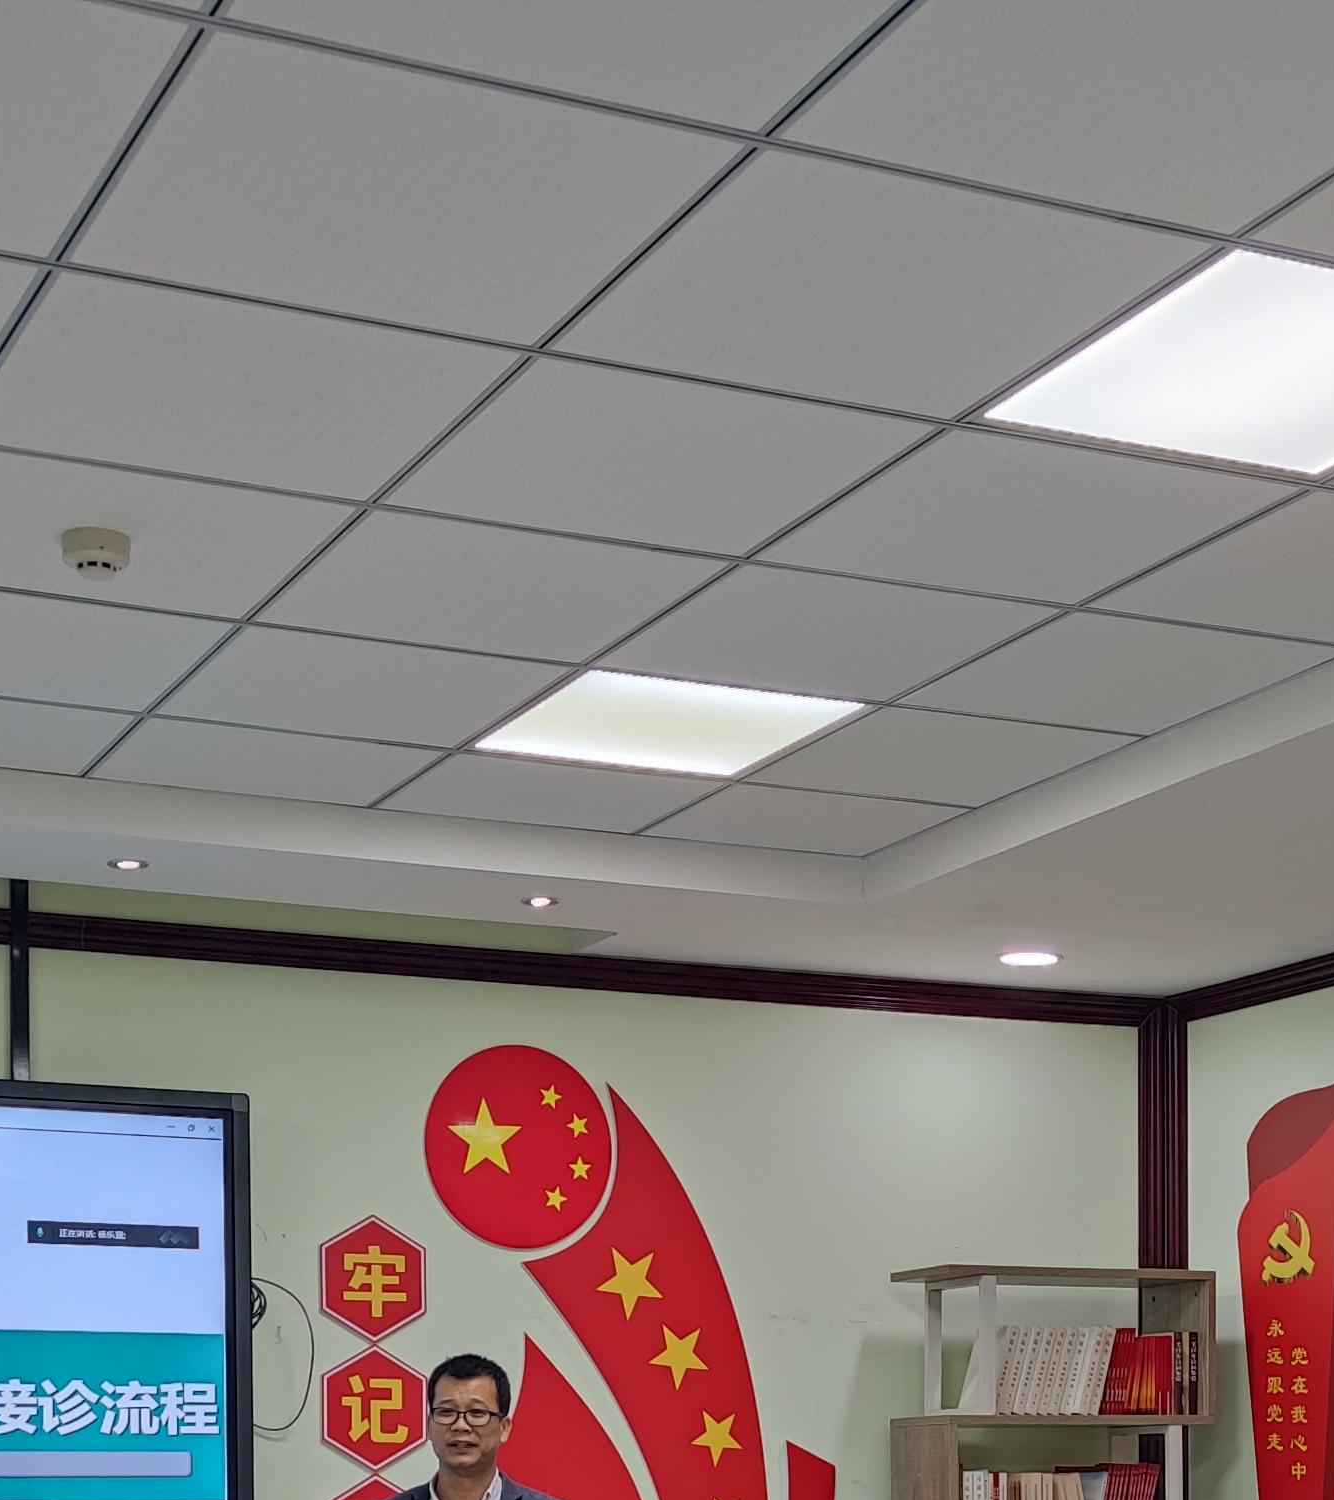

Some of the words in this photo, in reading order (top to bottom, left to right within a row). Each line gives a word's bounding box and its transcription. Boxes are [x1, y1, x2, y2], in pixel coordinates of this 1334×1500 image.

[1266, 1318, 1285, 1452] 永远跟党走
[1290, 1347, 1308, 1481] 党在我心中
